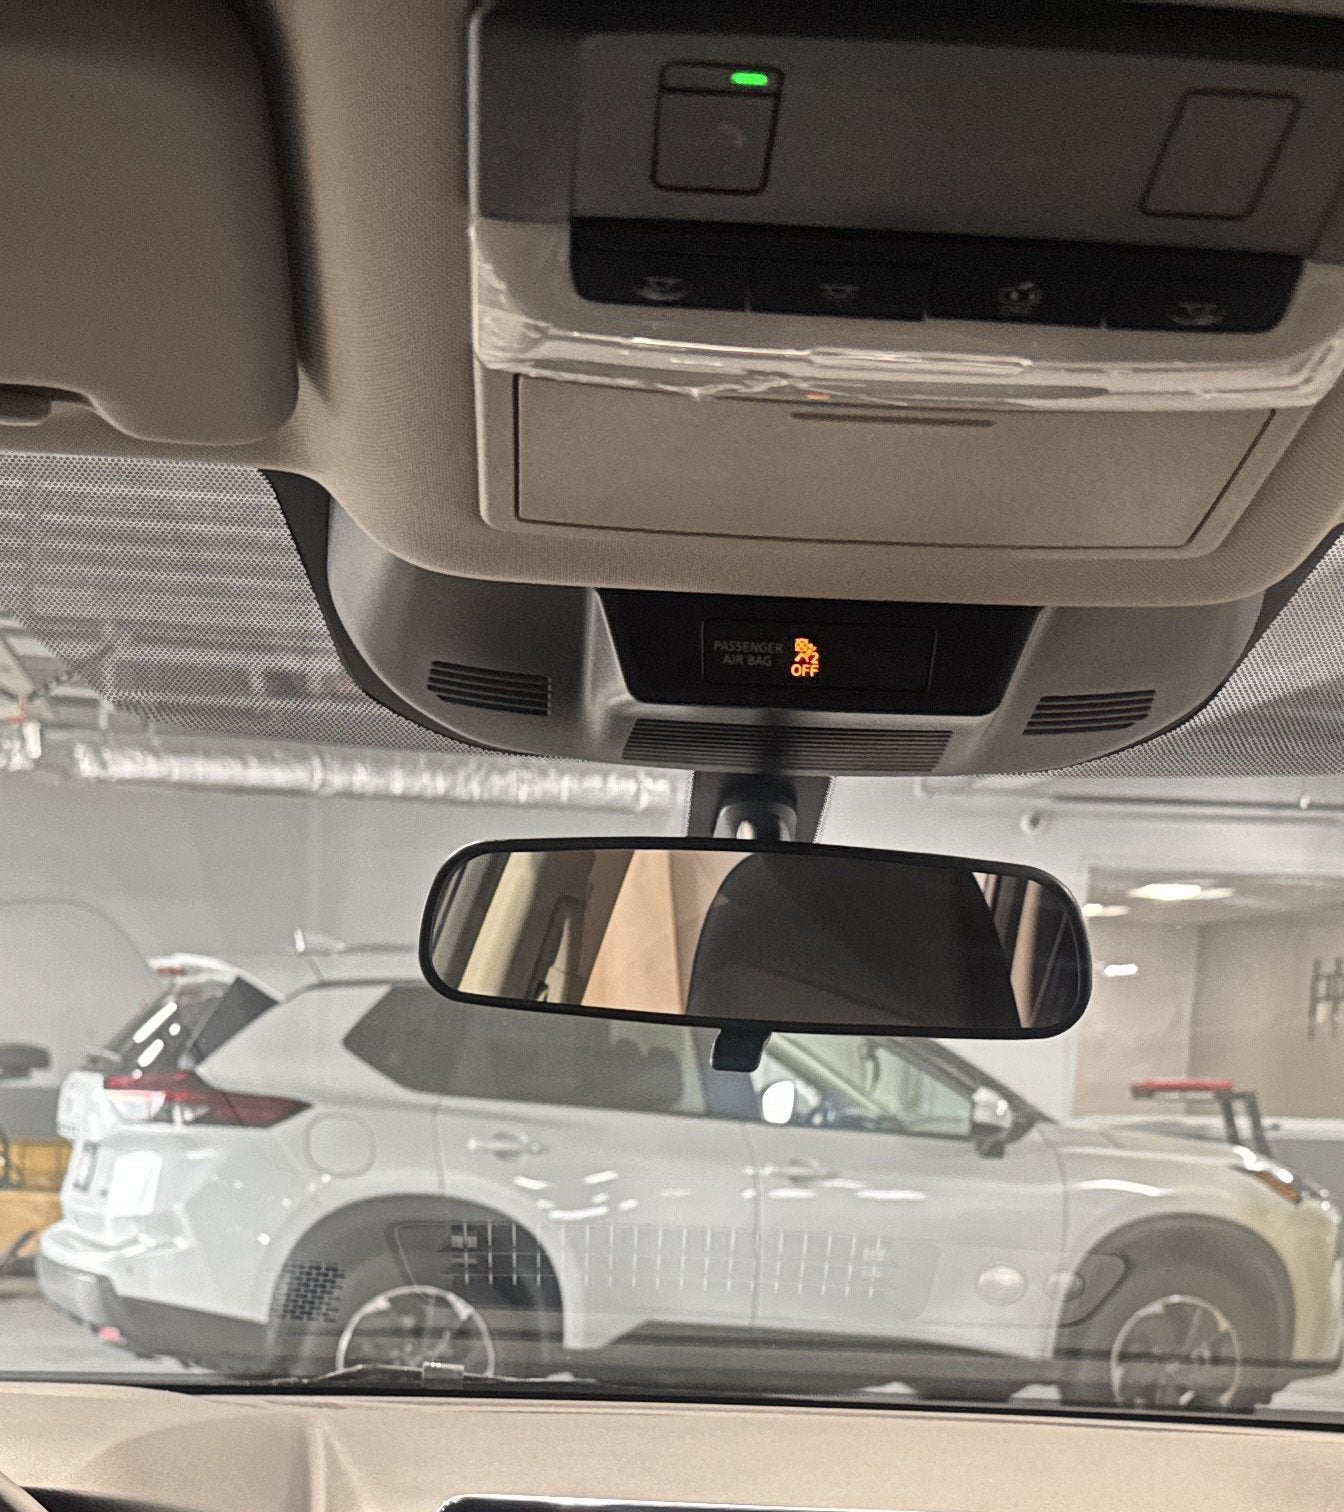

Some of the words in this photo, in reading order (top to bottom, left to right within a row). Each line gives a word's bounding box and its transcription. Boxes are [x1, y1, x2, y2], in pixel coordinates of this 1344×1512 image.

[714, 640, 783, 655] PASSENGER
[722, 653, 744, 666] AIR
[746, 655, 773, 667] BAG
[790, 663, 820, 678] OFF
